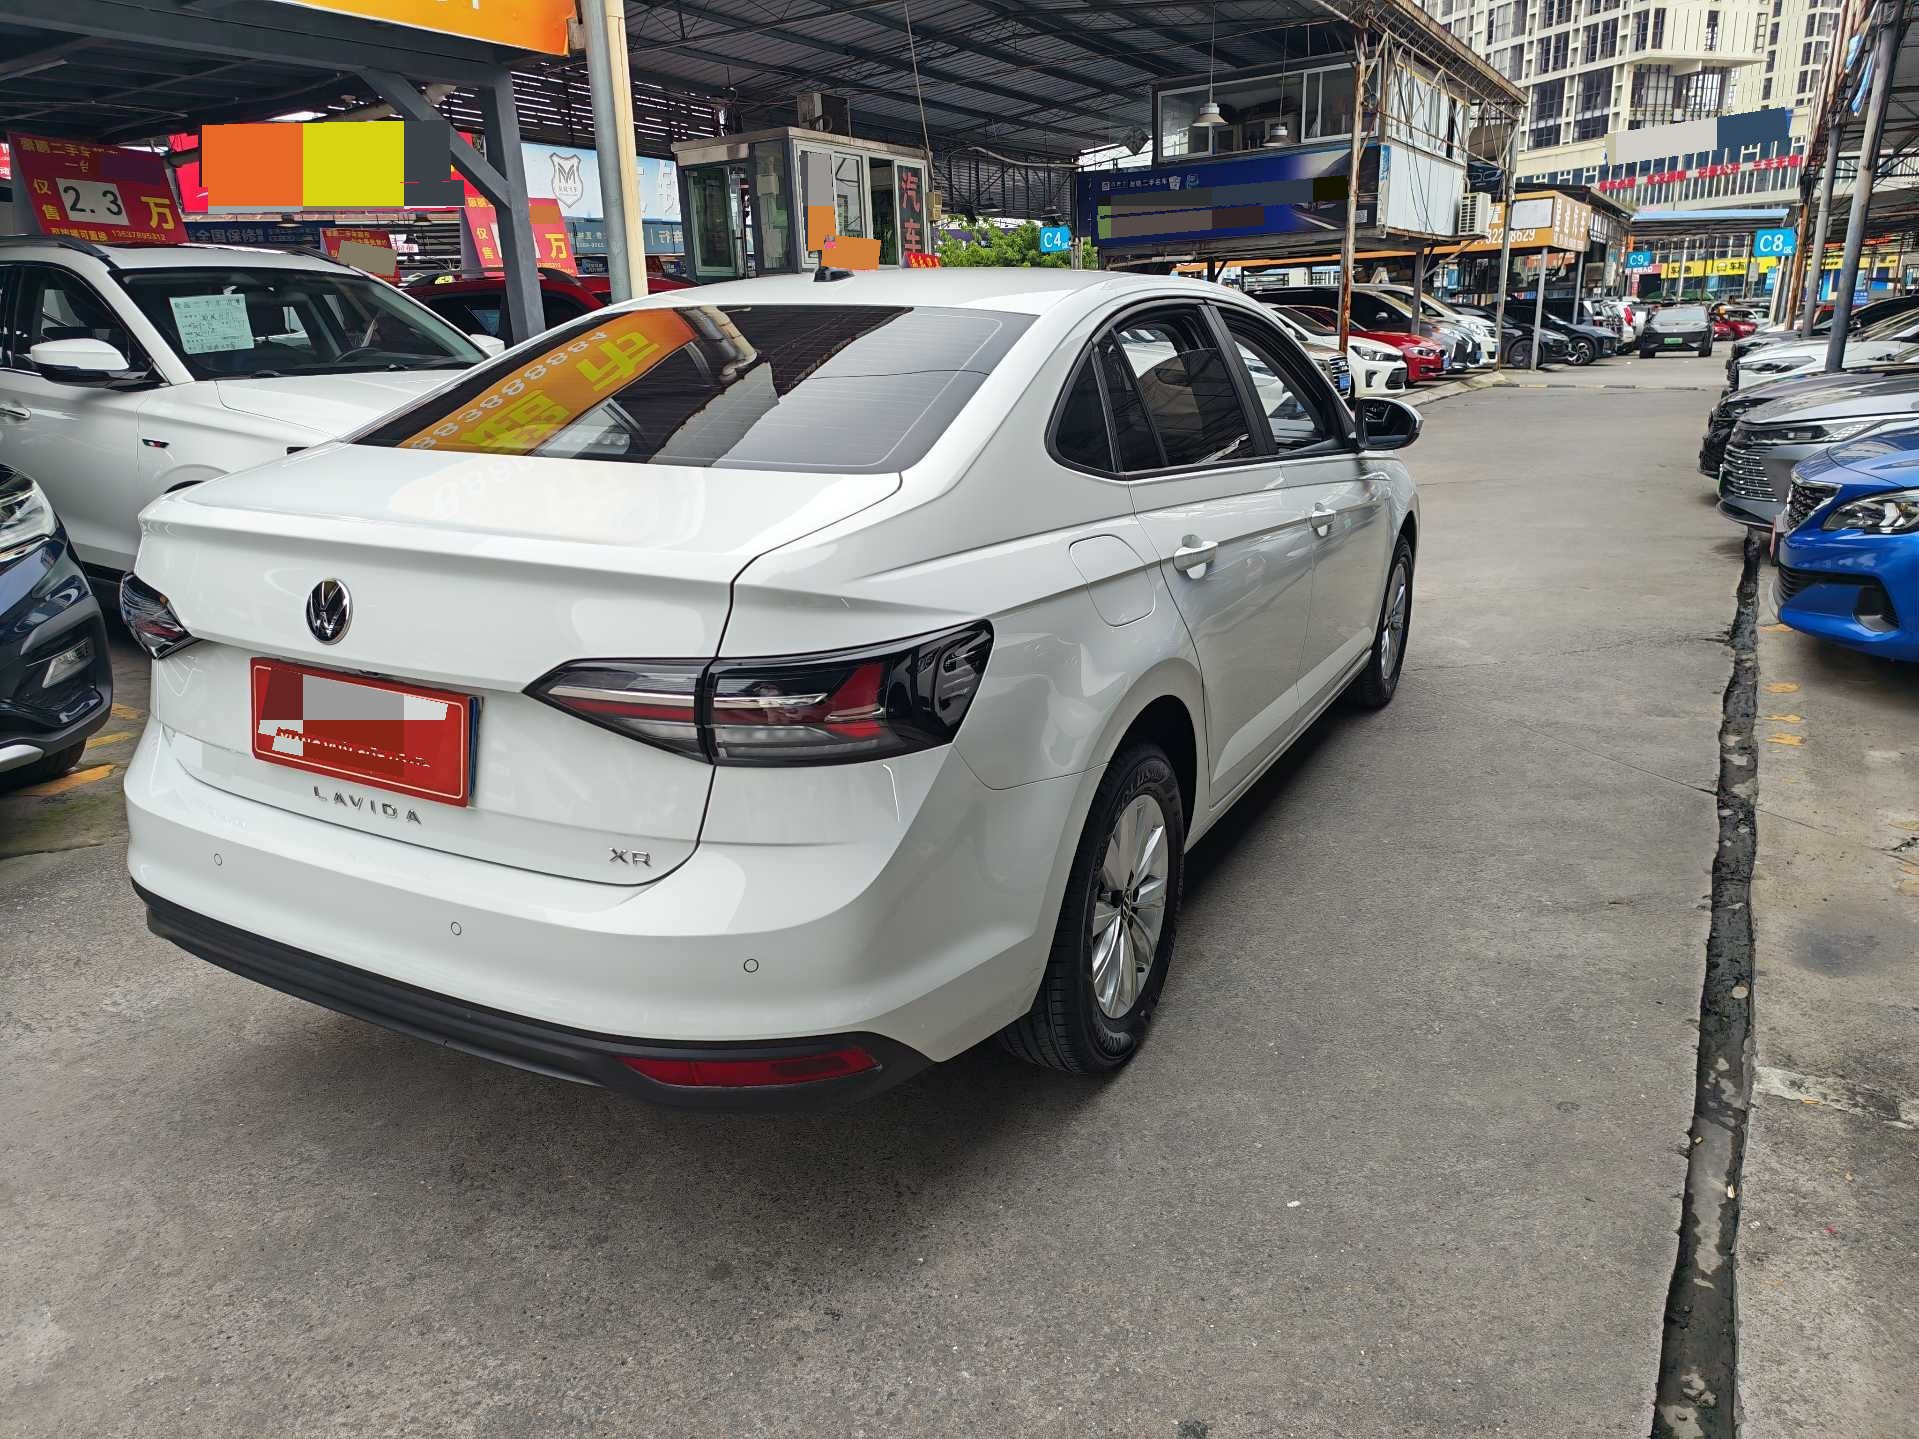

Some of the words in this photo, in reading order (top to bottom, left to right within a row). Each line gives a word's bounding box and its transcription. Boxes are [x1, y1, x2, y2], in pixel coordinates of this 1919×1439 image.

[63, 185, 122, 216] 2.3
[140, 196, 175, 230] 万
[544, 233, 568, 260] 万
[313, 784, 423, 826] LAVIDA
[608, 847, 653, 867] XR
